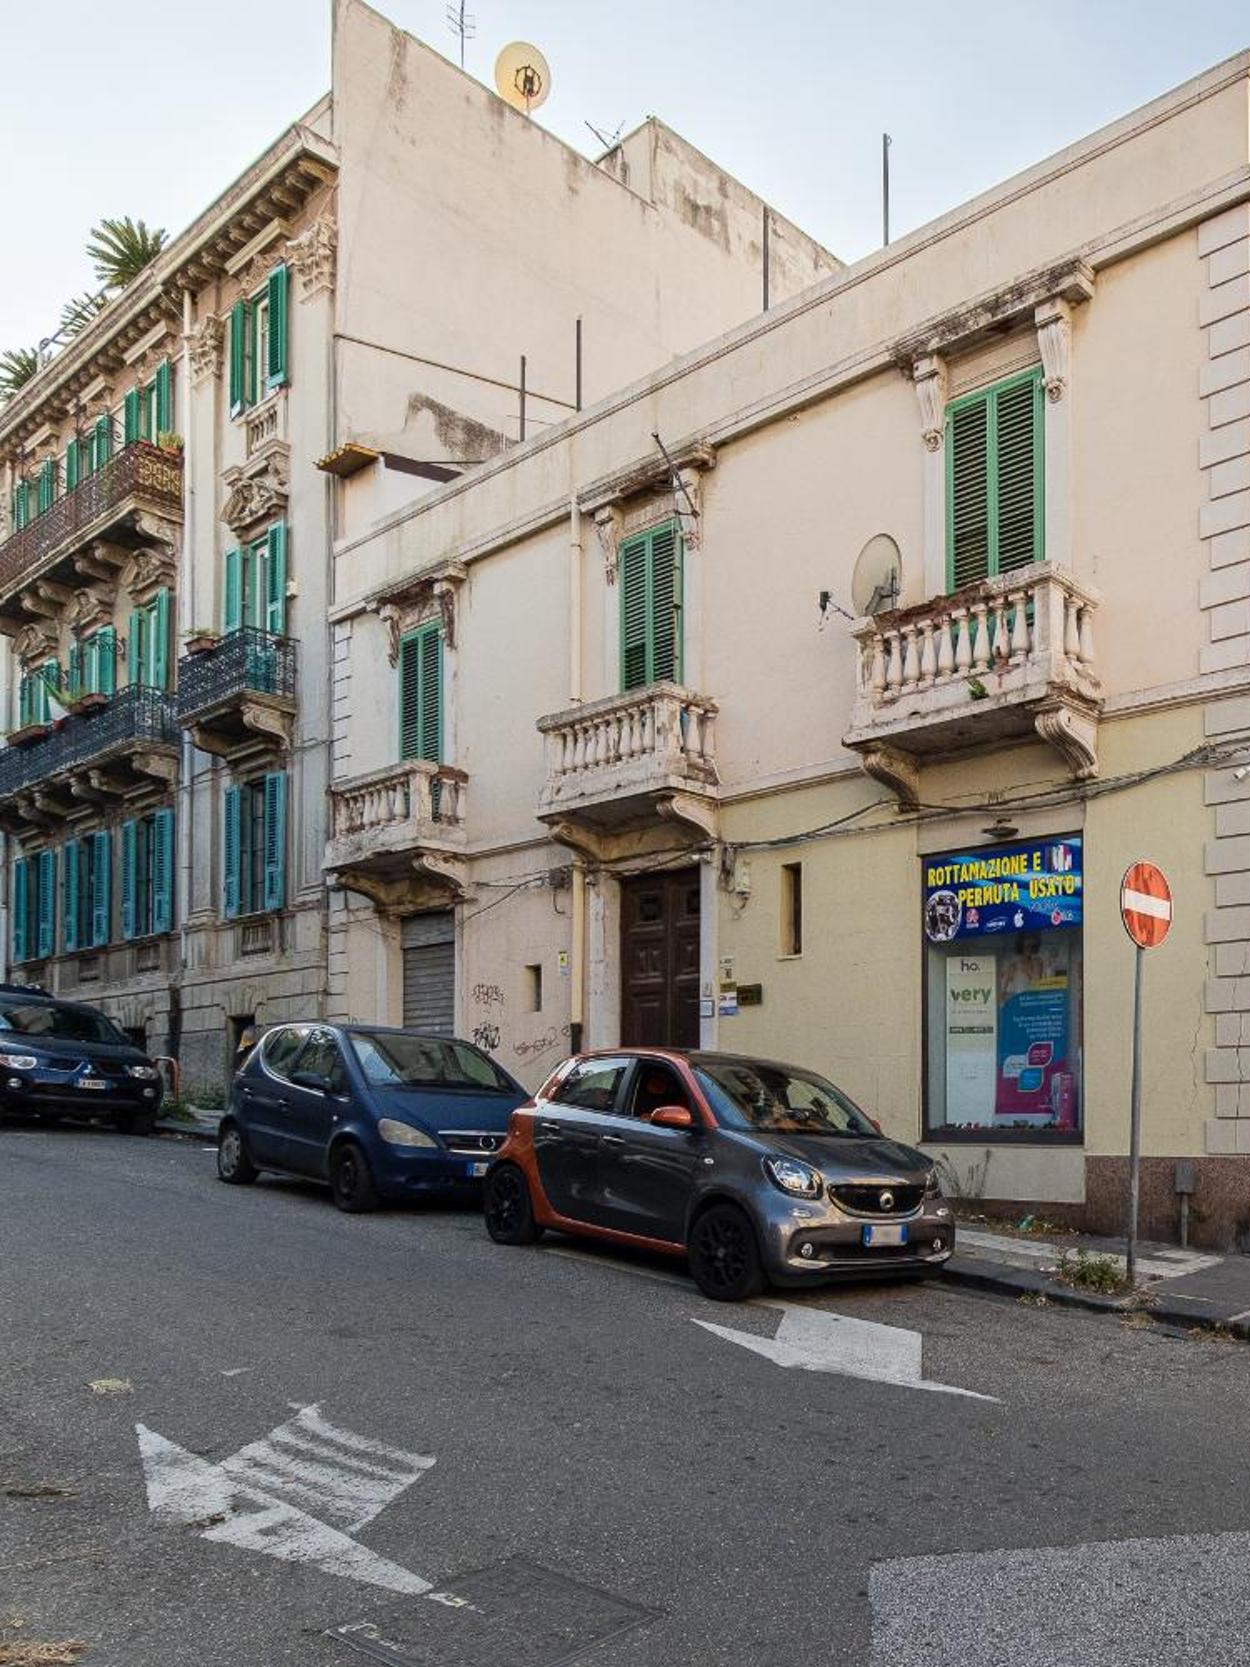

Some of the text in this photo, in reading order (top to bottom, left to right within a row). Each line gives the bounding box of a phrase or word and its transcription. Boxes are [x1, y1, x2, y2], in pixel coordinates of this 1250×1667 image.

[928, 851, 1041, 887] ROTTAMAZIONE E
[958, 882, 1020, 908] PERMUTA
[1029, 875, 1076, 899] USATO
[950, 986, 992, 1004] very
